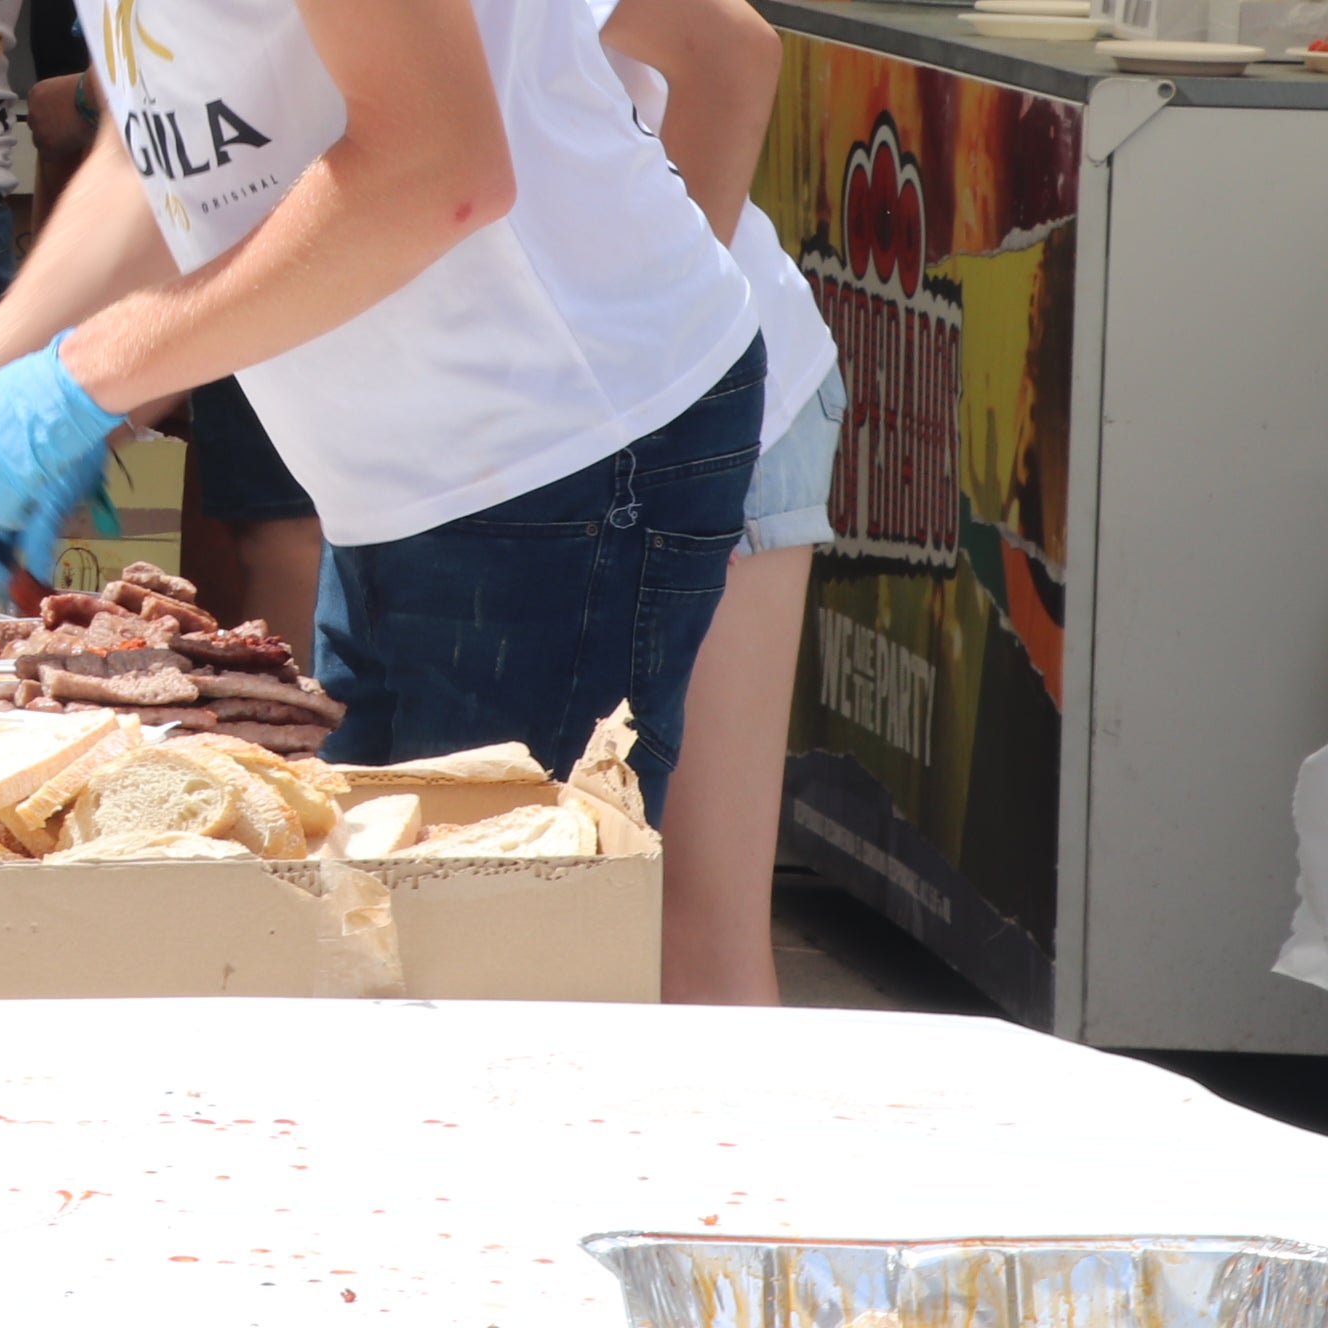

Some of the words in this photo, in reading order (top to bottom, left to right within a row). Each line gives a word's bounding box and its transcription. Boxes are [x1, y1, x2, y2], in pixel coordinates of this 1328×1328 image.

[201, 174, 279, 214] ORIGINAL
[807, 269, 963, 554] SPERADOS
[819, 607, 853, 719] WE
[854, 623, 876, 678] ARE
[853, 673, 875, 733] THE
[875, 633, 937, 768] PARTY
